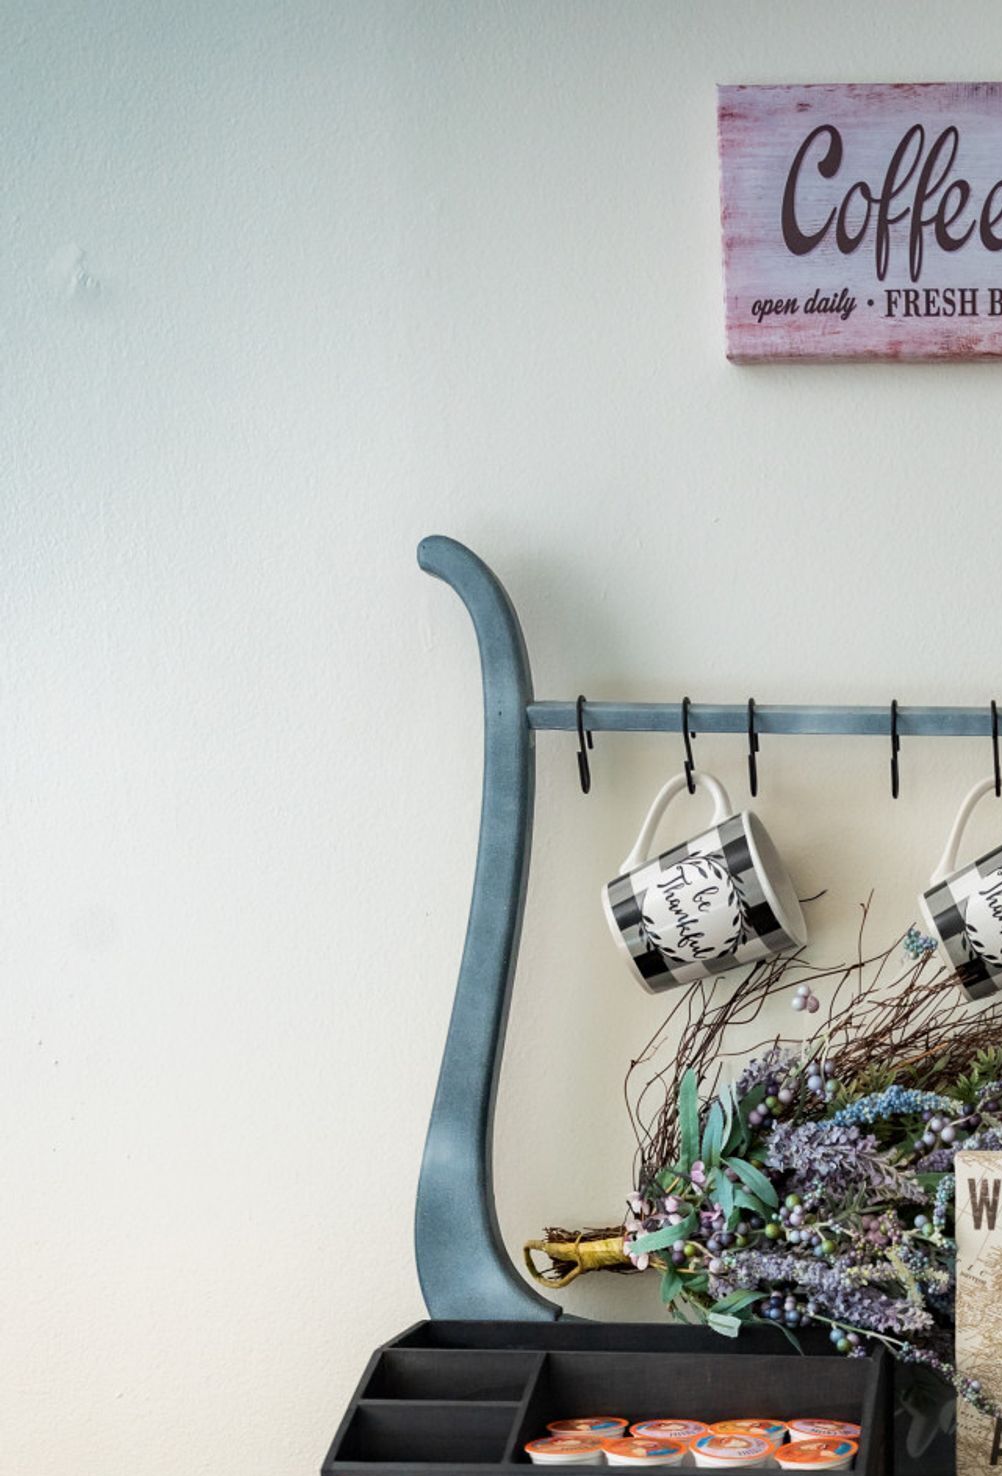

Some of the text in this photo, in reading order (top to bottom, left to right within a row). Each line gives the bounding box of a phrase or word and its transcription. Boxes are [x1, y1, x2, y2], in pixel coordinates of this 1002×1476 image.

[751, 297, 799, 323] open
[803, 287, 857, 320] daily
[884, 288, 979, 318] FRESH
[657, 865, 715, 959] Thankful
[692, 885, 719, 913] be
